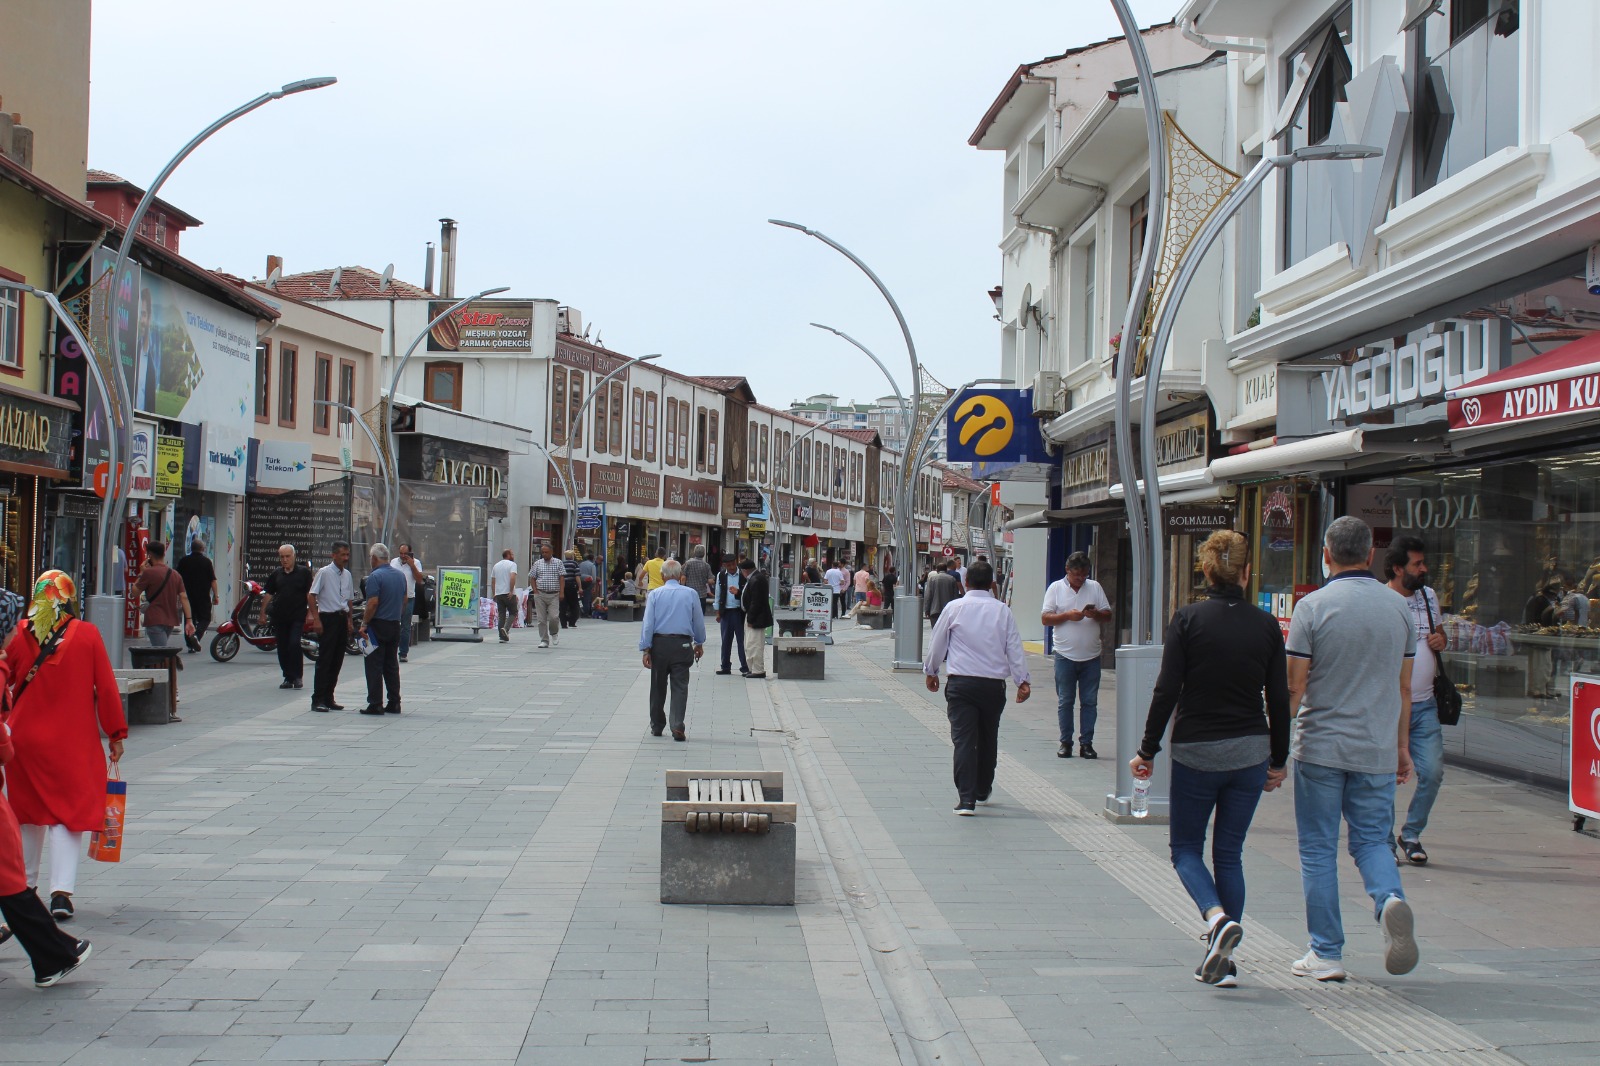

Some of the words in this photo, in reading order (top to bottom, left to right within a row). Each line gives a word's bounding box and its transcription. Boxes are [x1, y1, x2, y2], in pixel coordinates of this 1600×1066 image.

[465, 330, 496, 339] MEŞHUR
[498, 330, 527, 338] YOZGAT
[597, 358, 625, 377] EMLK
[1502, 383, 1558, 418] AYDIN
[1569, 375, 1600, 408] KU
[209, 450, 220, 464] Türk
[219, 452, 237, 467] Telekom
[265, 464, 294, 472] Telekom
[1168, 513, 1228, 526] SOLMAZLAR
[128, 530, 137, 577] TAVUK
[442, 595, 464, 608] 299
[807, 596, 829, 604] BARBER
